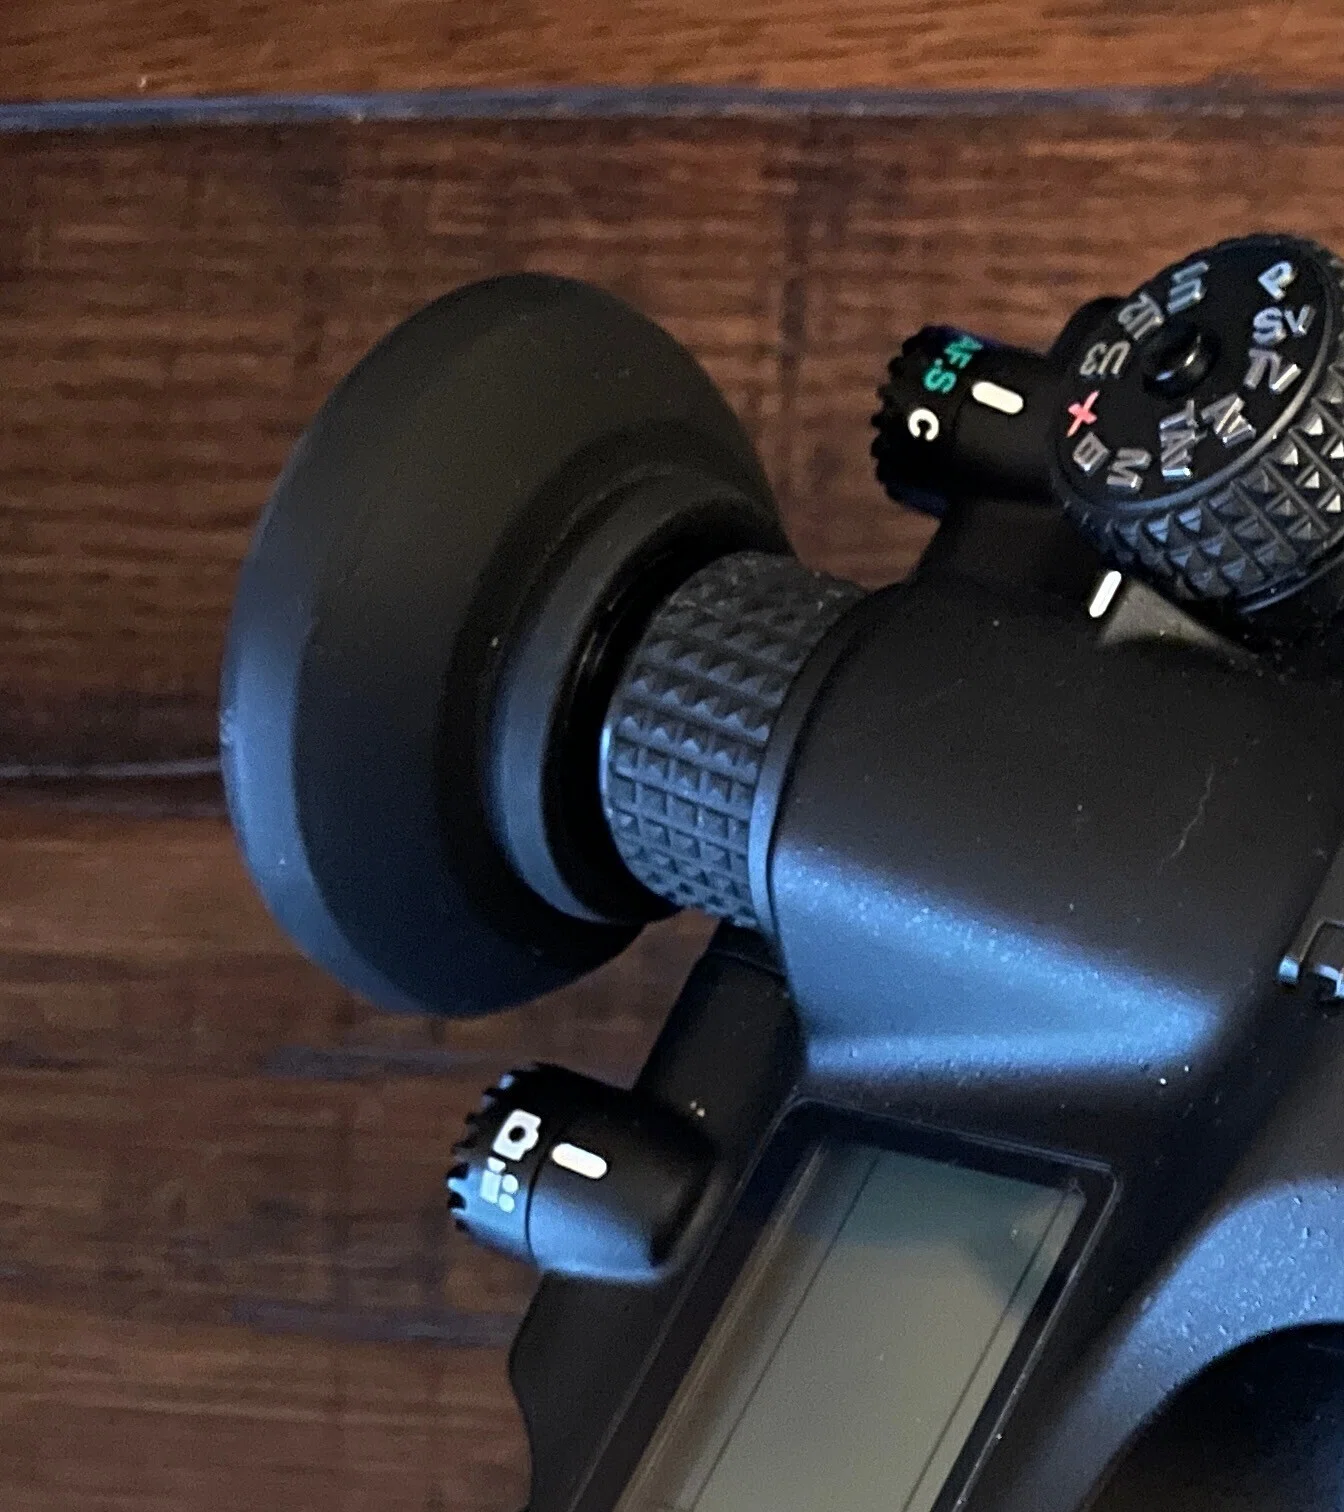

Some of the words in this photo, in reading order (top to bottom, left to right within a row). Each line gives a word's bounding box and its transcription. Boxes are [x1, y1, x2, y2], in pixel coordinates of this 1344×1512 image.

[1258, 260, 1296, 301] P
[1079, 341, 1132, 376] U3
[907, 407, 940, 442] C
[1106, 446, 1152, 490] M
